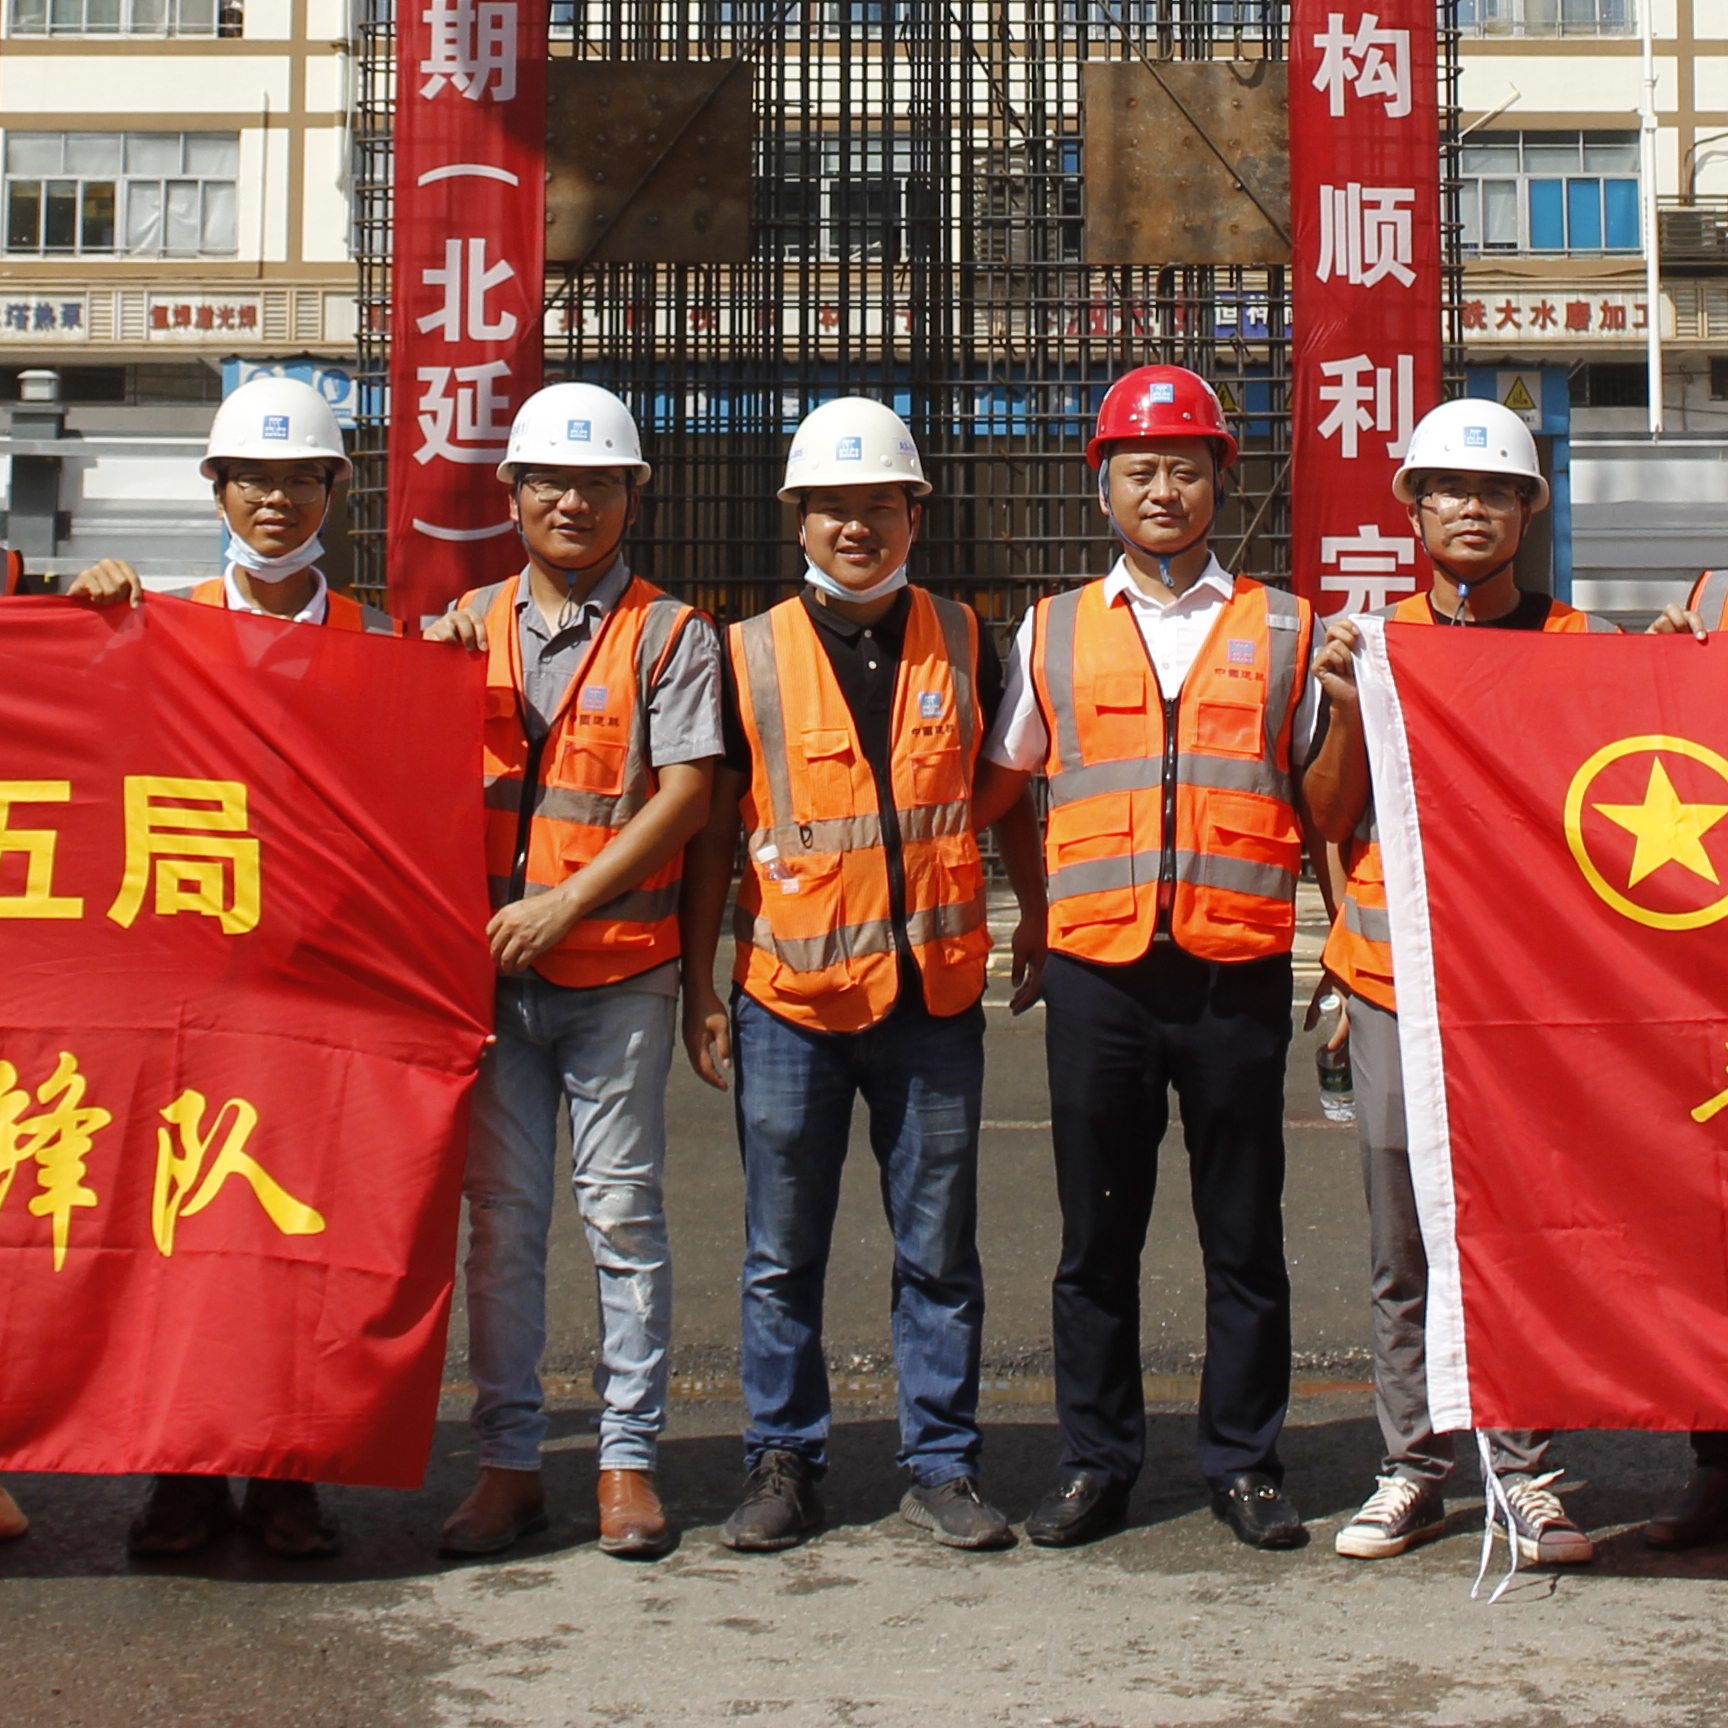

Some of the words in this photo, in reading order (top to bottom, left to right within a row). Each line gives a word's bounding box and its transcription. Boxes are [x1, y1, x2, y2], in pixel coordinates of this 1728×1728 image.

[1442, 298, 1648, 331] 铣大水磨加工
